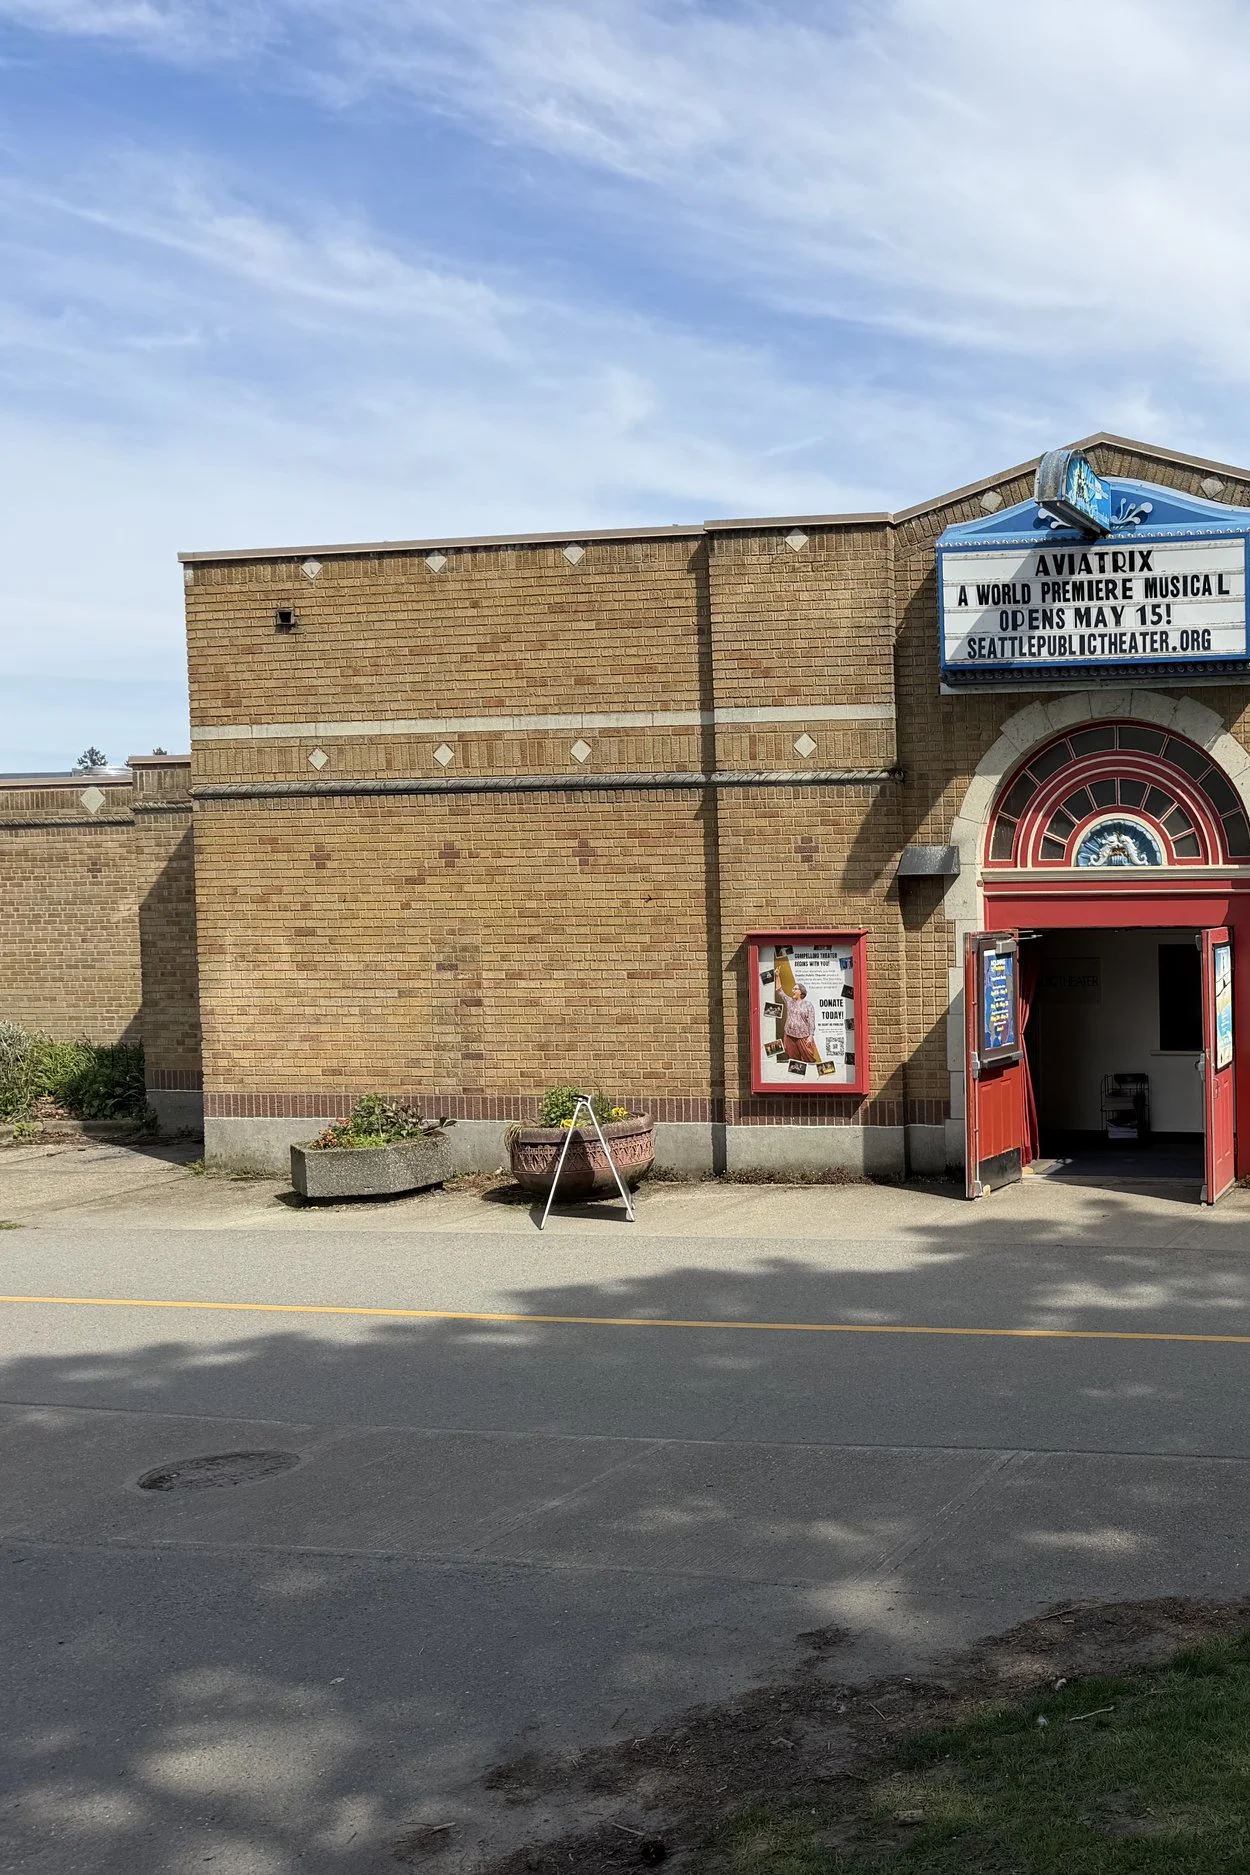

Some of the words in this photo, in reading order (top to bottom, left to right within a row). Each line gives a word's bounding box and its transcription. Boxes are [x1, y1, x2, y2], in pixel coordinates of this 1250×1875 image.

[1035, 550, 1153, 576] AVIATRIX
[958, 585, 968, 606] A
[976, 583, 1031, 605] WORLD
[1041, 578, 1133, 603] PREMIERE
[1144, 573, 1230, 599] MUSICAL
[1000, 607, 1066, 631] OPENS
[1074, 605, 1125, 628] MAY
[1135, 603, 1172, 626] 15!
[967, 628, 1212, 659] SEATTLEPUBLICTHEATER.ORG
[819, 999, 844, 1007] DONATE
[821, 1011, 844, 1019] TODAY!
